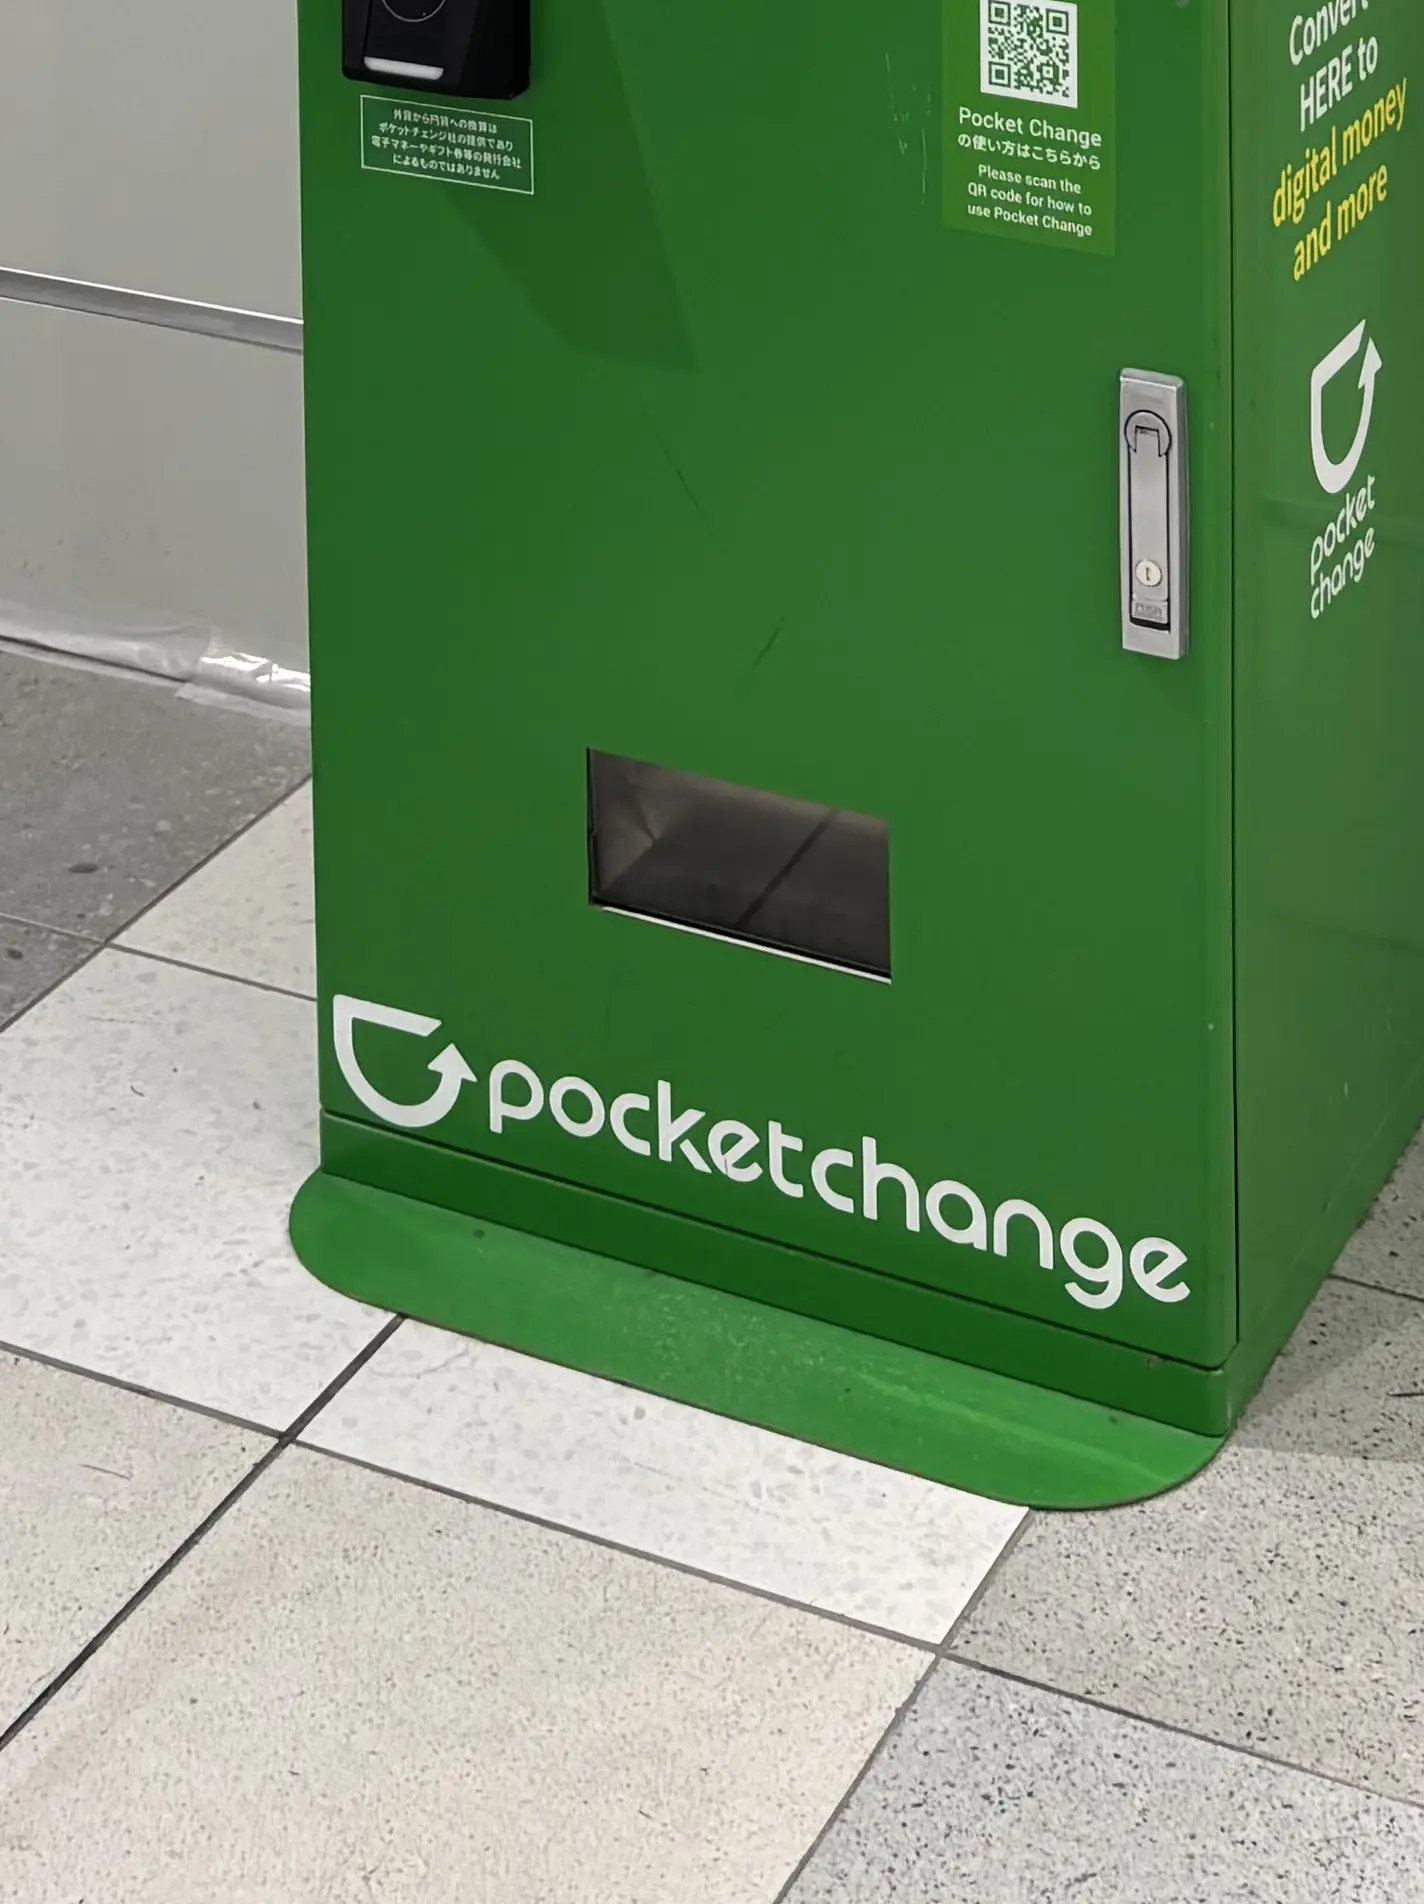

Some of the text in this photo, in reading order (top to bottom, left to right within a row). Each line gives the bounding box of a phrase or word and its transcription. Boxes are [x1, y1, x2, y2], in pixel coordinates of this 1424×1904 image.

[959, 106, 1102, 150] Pocket Change
[1300, 36, 1378, 133] HERE to
[957, 134, 1101, 171] の使い方はこちらから
[978, 164, 1081, 194] Please scan the
[1273, 77, 1407, 227] digital money
[967, 204, 1092, 237] use Pocket Change
[968, 181, 1092, 216] QR code for how to
[1292, 165, 1387, 282] and more
[1311, 475, 1375, 585] pocket
[1311, 527, 1374, 619] change
[489, 1059, 1192, 1311] pocketchange
